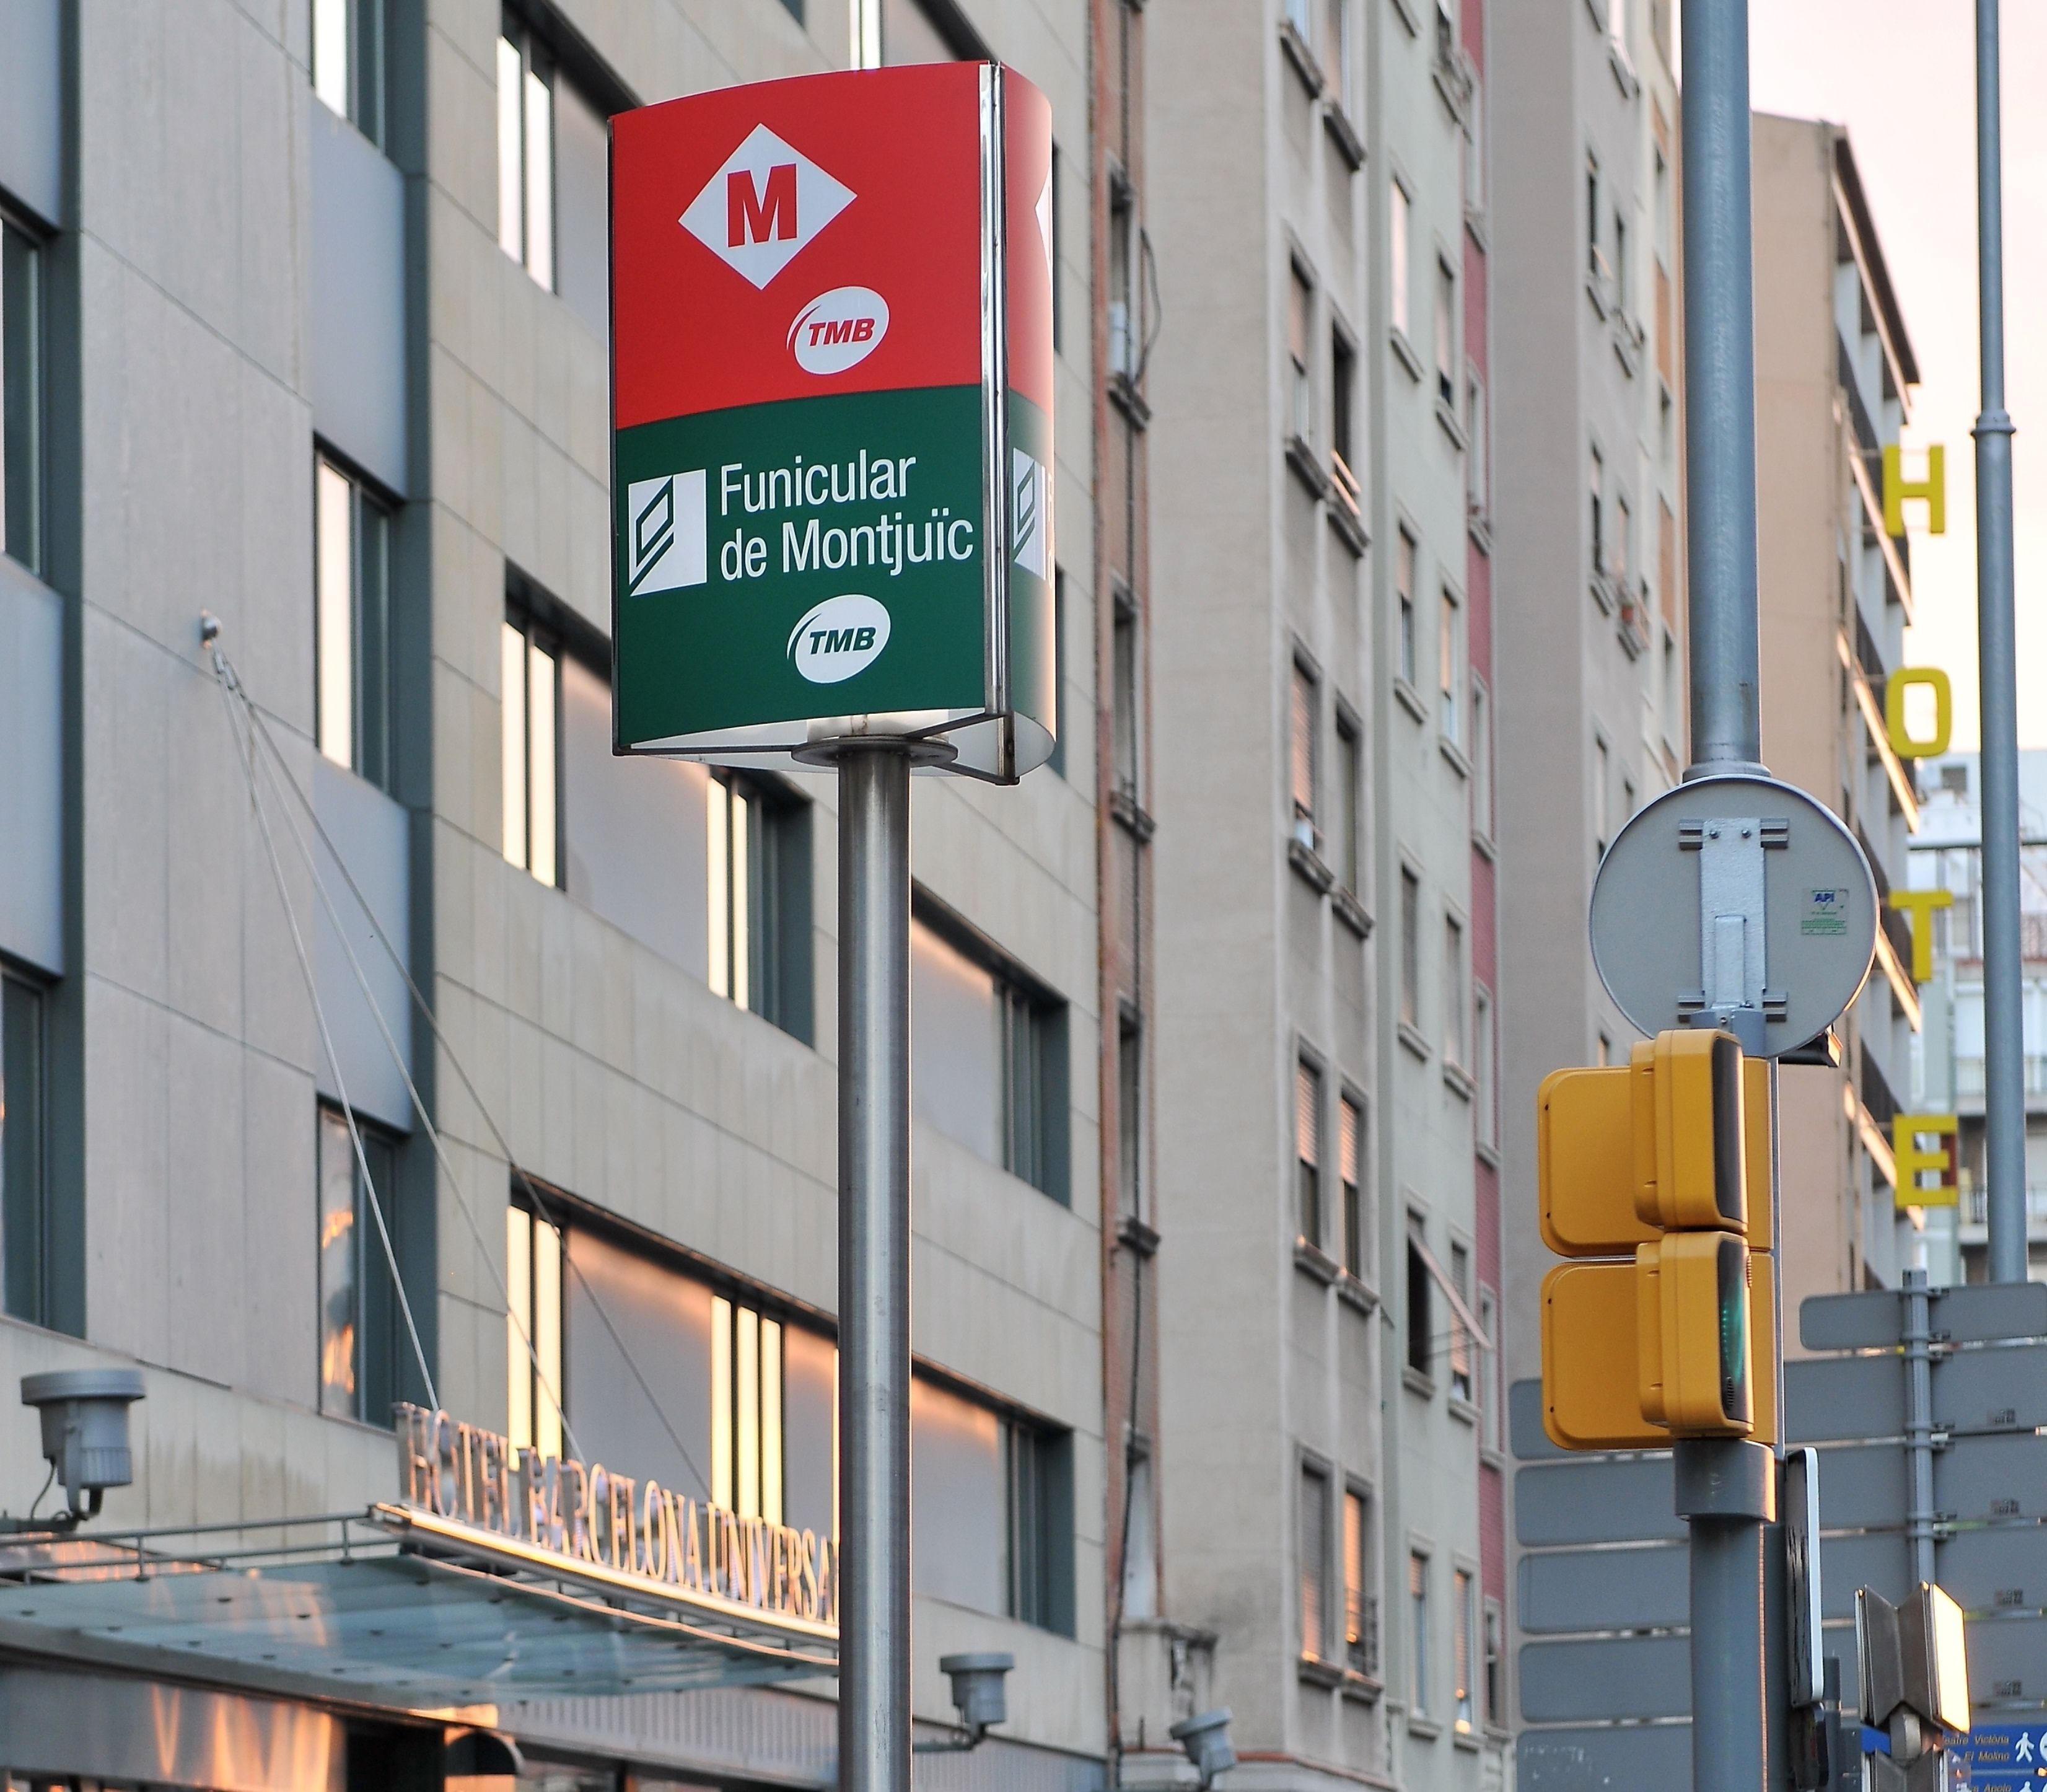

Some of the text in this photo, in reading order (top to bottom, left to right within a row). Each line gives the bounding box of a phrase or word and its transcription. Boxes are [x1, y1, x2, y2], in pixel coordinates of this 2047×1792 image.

[727, 163, 797, 248] M
[809, 318, 875, 346] TMB
[721, 449, 916, 516] Funicular
[721, 507, 973, 581] de Montjuïc
[810, 627, 876, 654] TMB
[1815, 893, 1834, 902] API
[393, 1402, 838, 1625] HOTEL BARCELONA UNIVERSA
[1944, 1736, 1969, 1744] eatre
[1979, 1750, 2010, 1761] Molino
